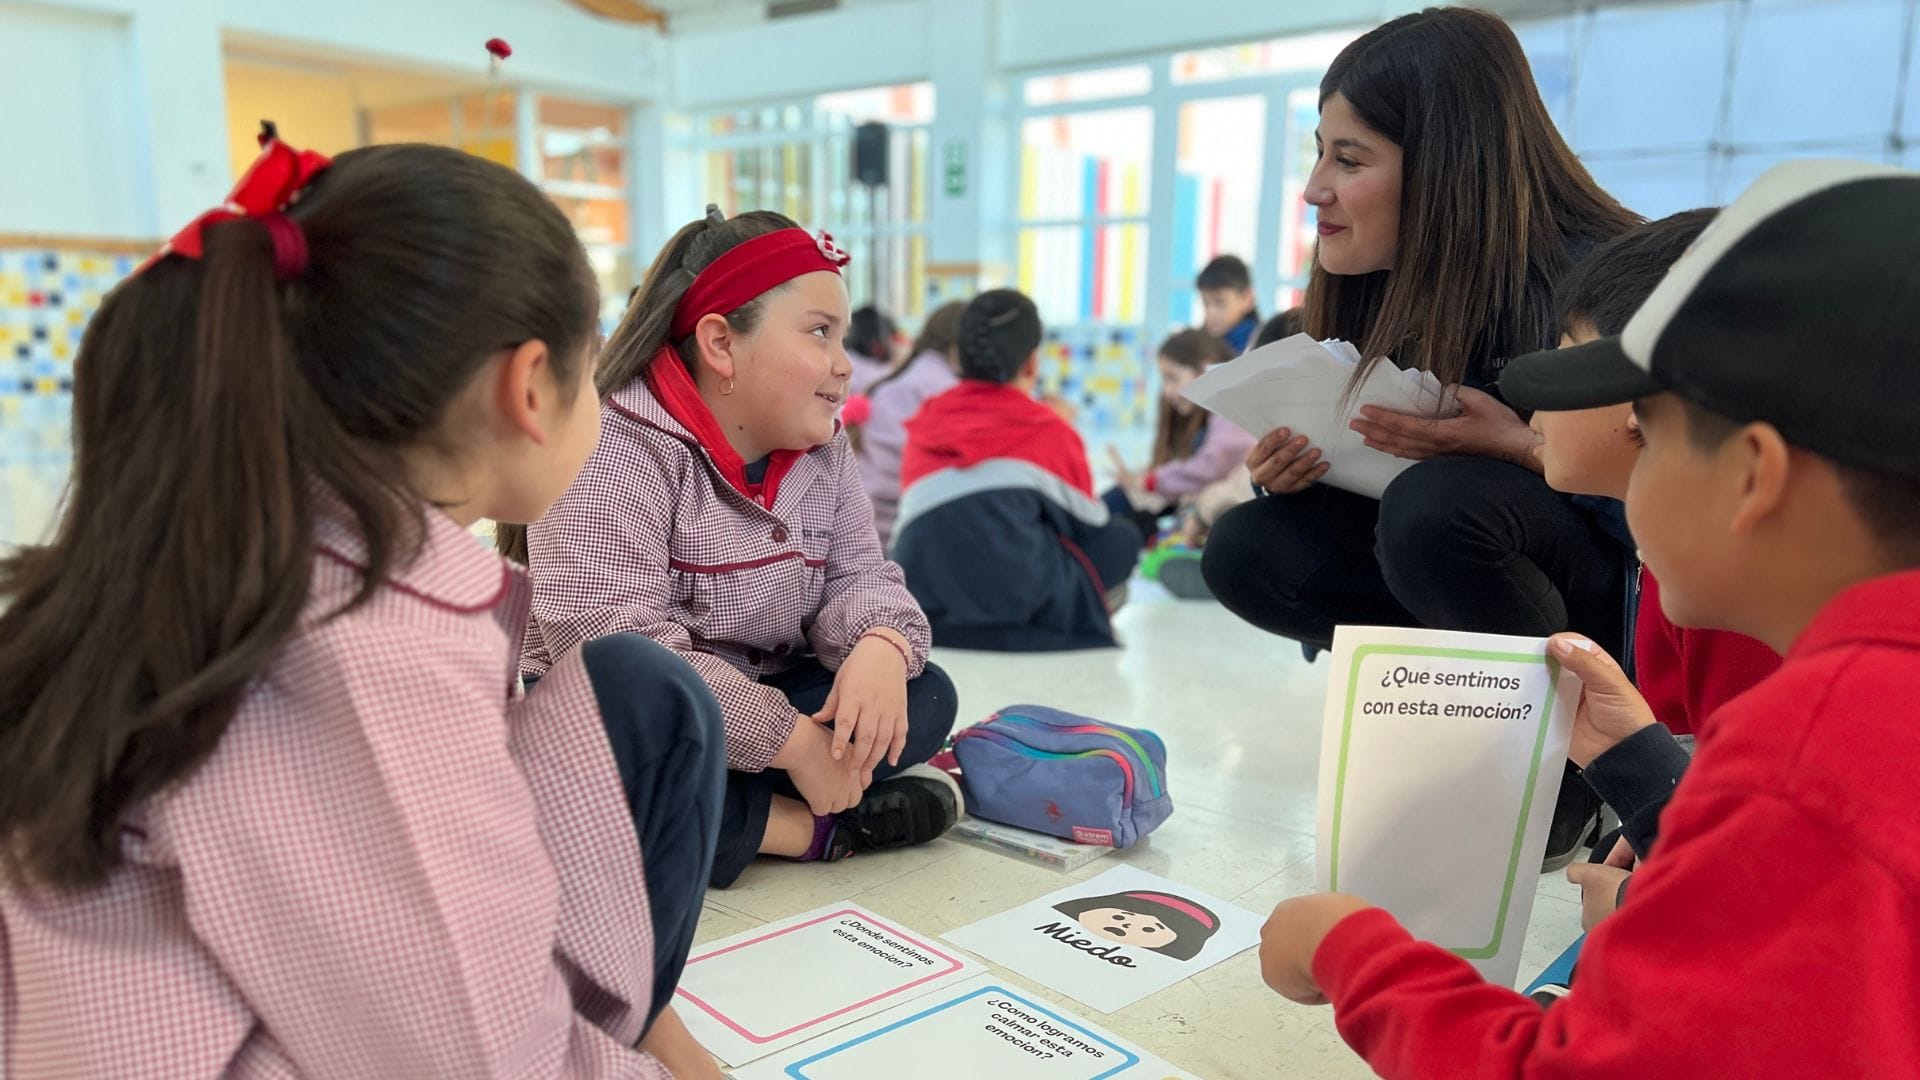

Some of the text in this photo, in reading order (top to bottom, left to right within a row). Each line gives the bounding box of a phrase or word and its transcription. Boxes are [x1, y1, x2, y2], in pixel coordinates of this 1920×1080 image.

[1433, 670, 1521, 691] sentimos
[1362, 701, 1394, 715] con
[1397, 699, 1439, 716] esta
[832, 927, 859, 943] esta
[1033, 921, 1137, 968] Miedo
[882, 938, 935, 966] sentimos
[990, 1012, 1074, 1058] calmar esta
[1036, 1021, 1105, 1058] logramos
